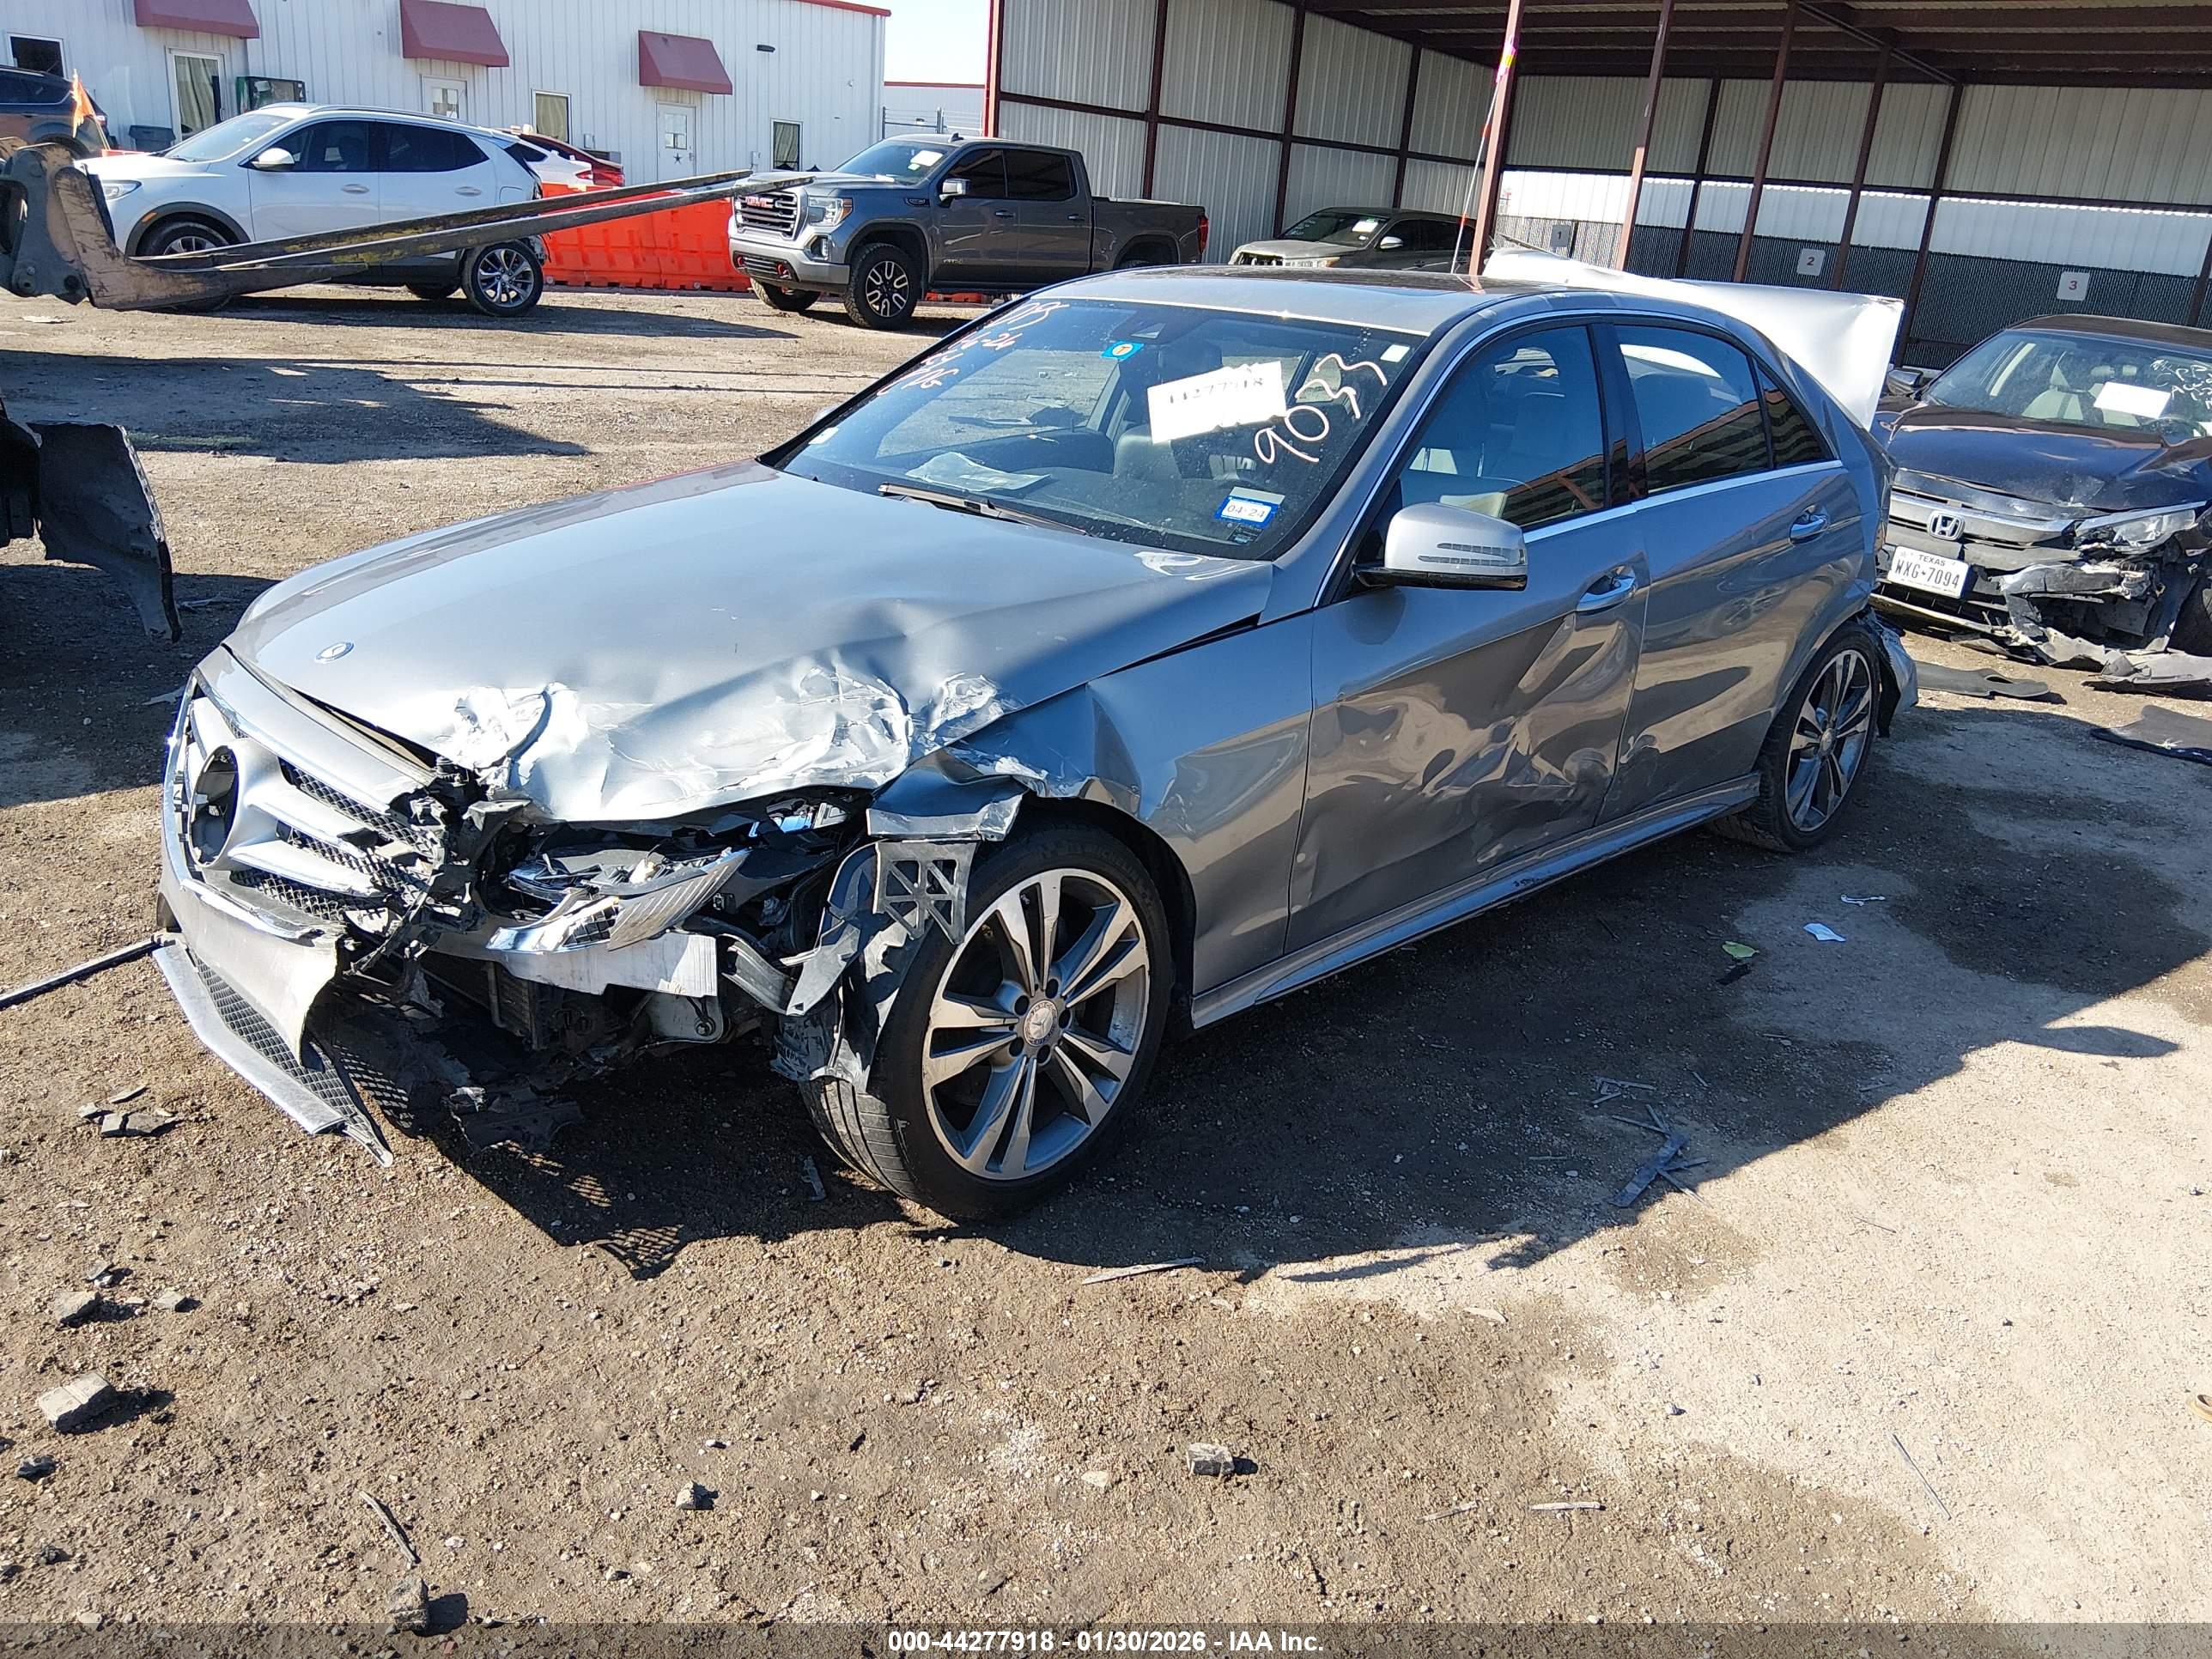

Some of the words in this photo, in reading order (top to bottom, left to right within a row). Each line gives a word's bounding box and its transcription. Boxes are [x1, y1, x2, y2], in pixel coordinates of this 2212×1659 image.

[1807, 257, 1815, 266] 2
[2069, 280, 2078, 290] 3
[1254, 353, 1388, 464] 9033
[1918, 554, 1946, 567] TEXAS
